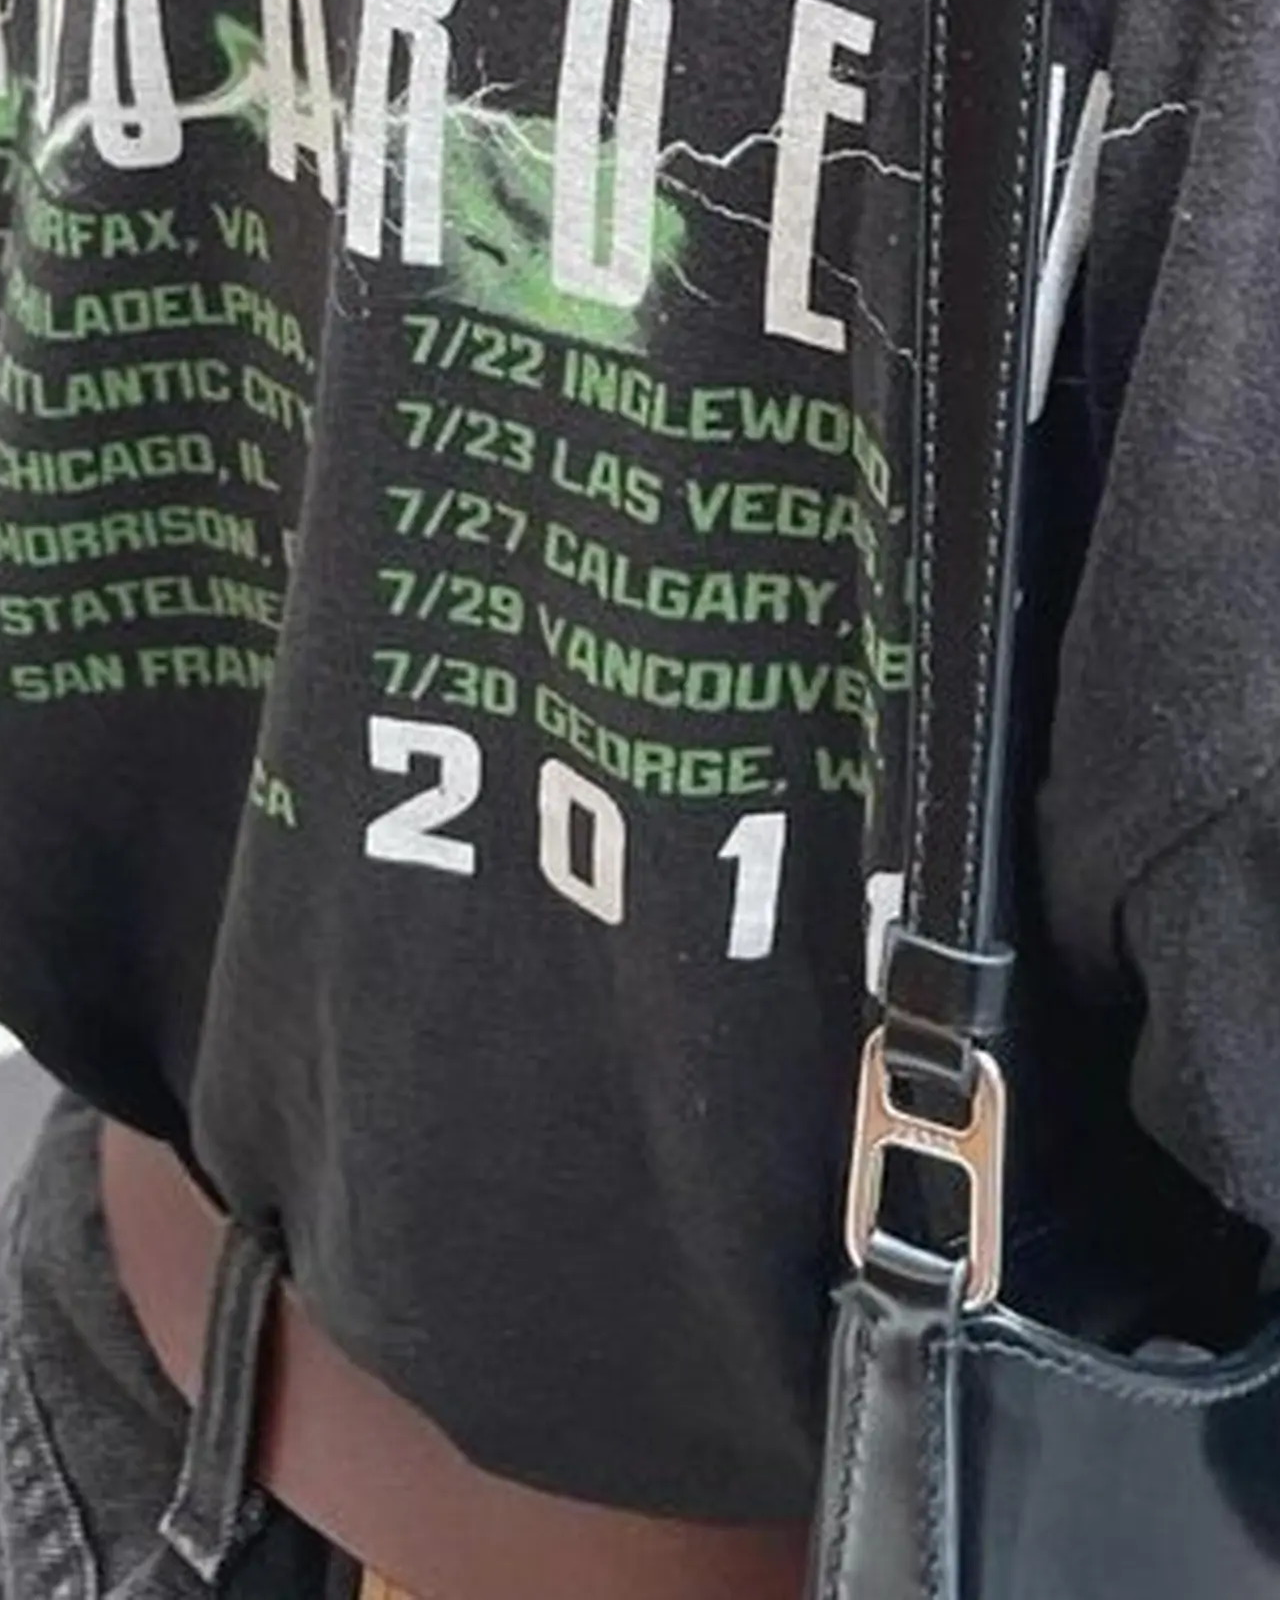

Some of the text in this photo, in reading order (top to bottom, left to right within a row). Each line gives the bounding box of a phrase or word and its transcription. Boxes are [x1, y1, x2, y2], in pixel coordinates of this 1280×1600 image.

[212, 202, 270, 263] VA
[402, 313, 546, 389] 7/22
[396, 400, 536, 475] 7/23
[550, 437, 663, 527] LAS
[385, 485, 529, 554] 7/27
[543, 521, 852, 637] CALGARY,
[378, 569, 524, 636] 7/29
[10, 652, 126, 702] SAN
[371, 650, 519, 718] 7/30
[535, 685, 789, 797] GEORGE,
